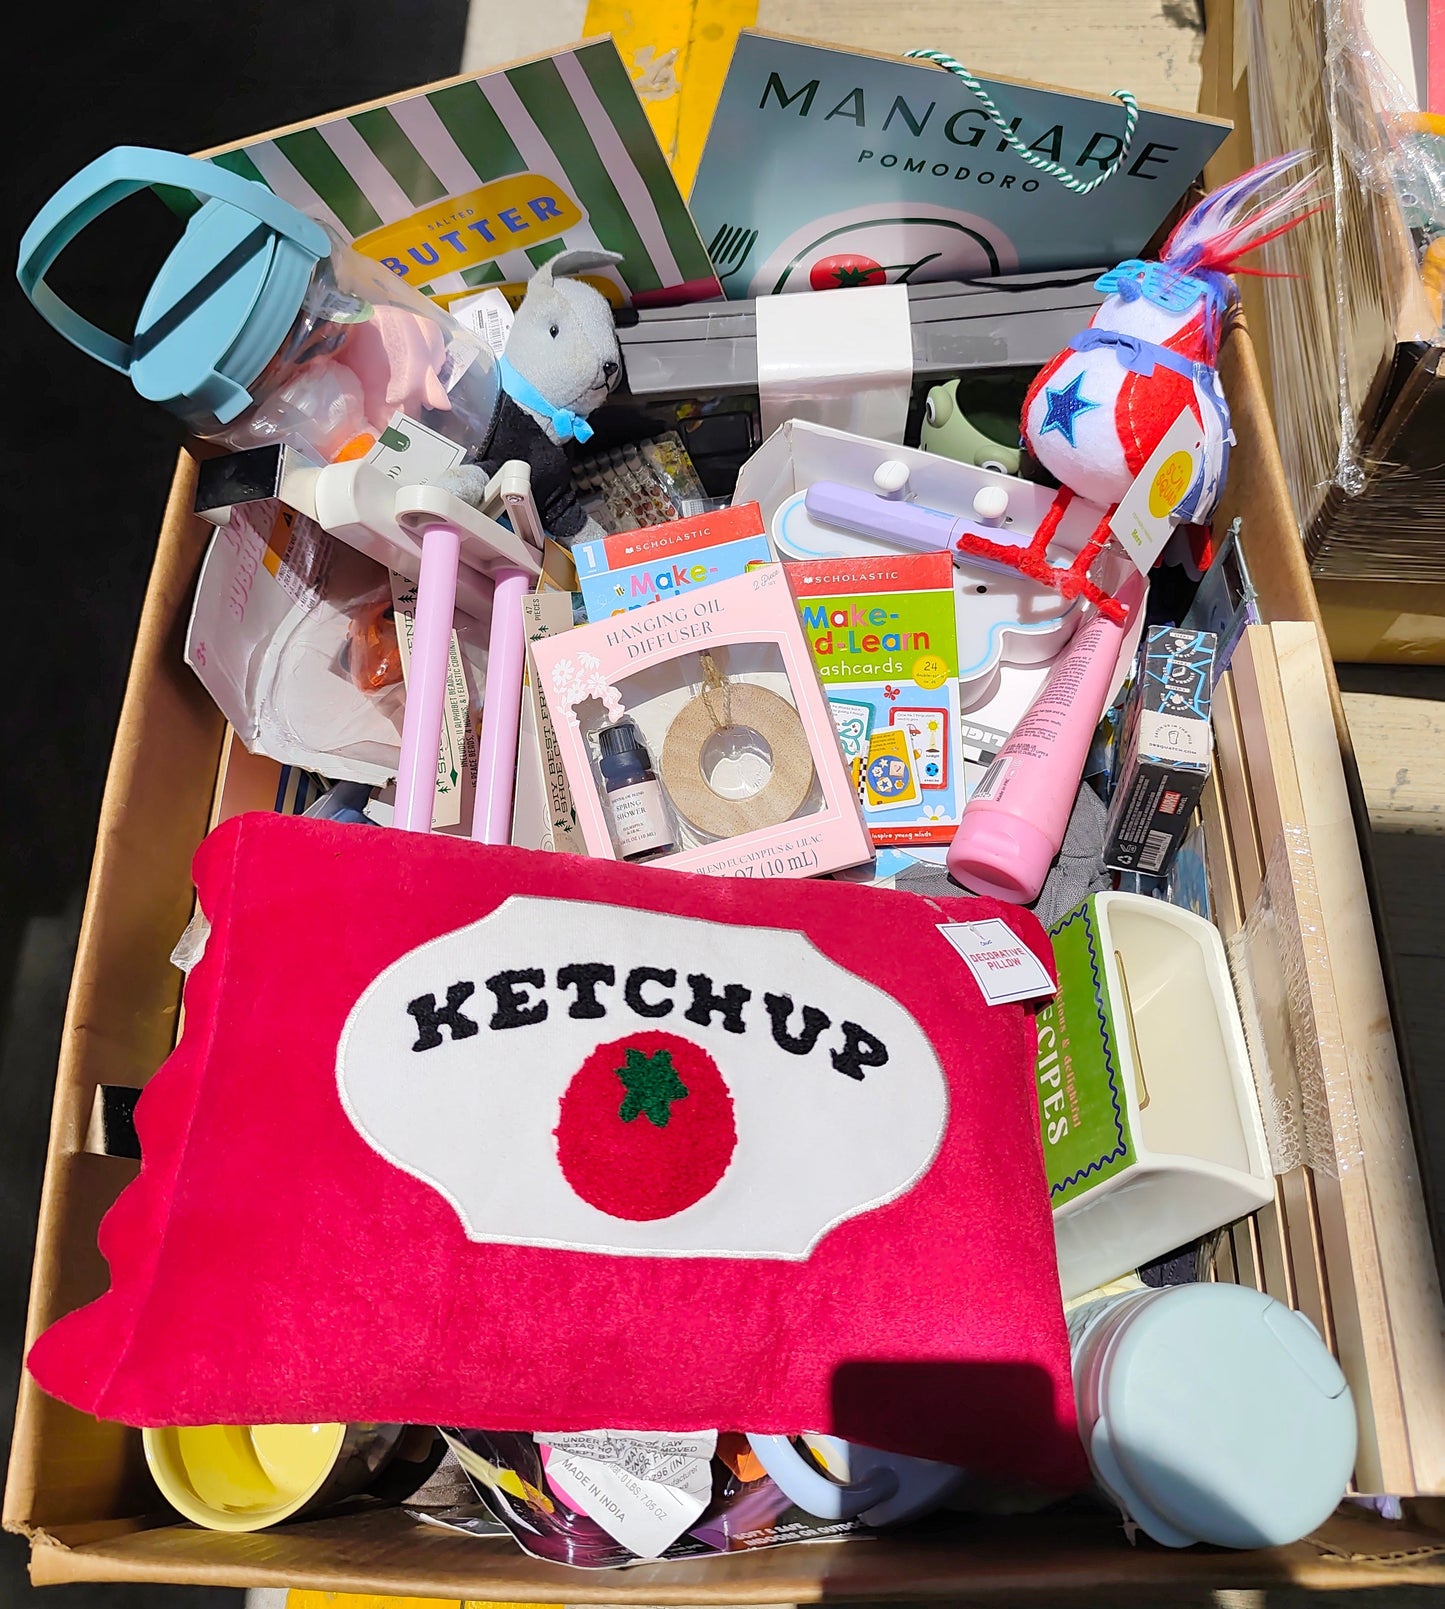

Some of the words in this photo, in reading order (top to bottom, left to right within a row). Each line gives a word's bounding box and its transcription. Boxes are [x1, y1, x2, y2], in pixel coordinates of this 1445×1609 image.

[758, 71, 1179, 181] MANGIARE
[858, 149, 1040, 193] POMODORO
[427, 208, 474, 231] SALTED
[379, 196, 563, 277] BUTTER
[635, 528, 711, 552] SCHOLASTIC
[582, 546, 596, 568] 1
[630, 562, 718, 597] Make-
[815, 571, 899, 584] SCHOLASTIC
[526, 606, 533, 615] 47
[533, 598, 542, 621] PIECES
[803, 604, 899, 630] Make-
[606, 607, 688, 646] HANGING
[693, 599, 725, 617] OIL
[626, 620, 713, 659] DIFFUSER
[814, 630, 930, 655] d-Learn
[820, 657, 903, 676] ashcards
[923, 661, 938, 671] 24
[454, 668, 465, 695] ELASTIC
[450, 697, 463, 729] ALPHABET
[543, 725, 555, 775] BEST
[551, 782, 561, 812] DIY
[555, 762, 568, 813] SHOE
[616, 800, 642, 811] SPRING
[617, 807, 647, 820] SHOWER
[1159, 791, 1181, 815] MARVEL
[871, 832, 893, 840] inspire
[894, 832, 912, 840] young
[914, 830, 931, 838] minds
[726, 843, 785, 869] EUCALYPTUS
[784, 843, 795, 853] &
[797, 833, 824, 849] LILAC
[760, 857, 784, 878] (10
[787, 848, 819, 870] mL)
[969, 947, 1026, 963] DECORATIVE
[987, 958, 1022, 971] PILLOW
[406, 963, 890, 1082] KETCHUP
[1062, 1038, 1070, 1049] &
[1063, 1055, 1081, 1128] delightful
[661, 1439, 683, 1447] LAW
[561, 1458, 590, 1487] MADE
[588, 1483, 600, 1499] IN
[599, 1492, 627, 1523] INDIA
[640, 1493, 656, 1512] 7.05
[654, 1508, 669, 1521] OZ
[743, 1531, 798, 1546] INDOORS
[798, 1528, 817, 1539] OR
[764, 1527, 775, 1536] &
